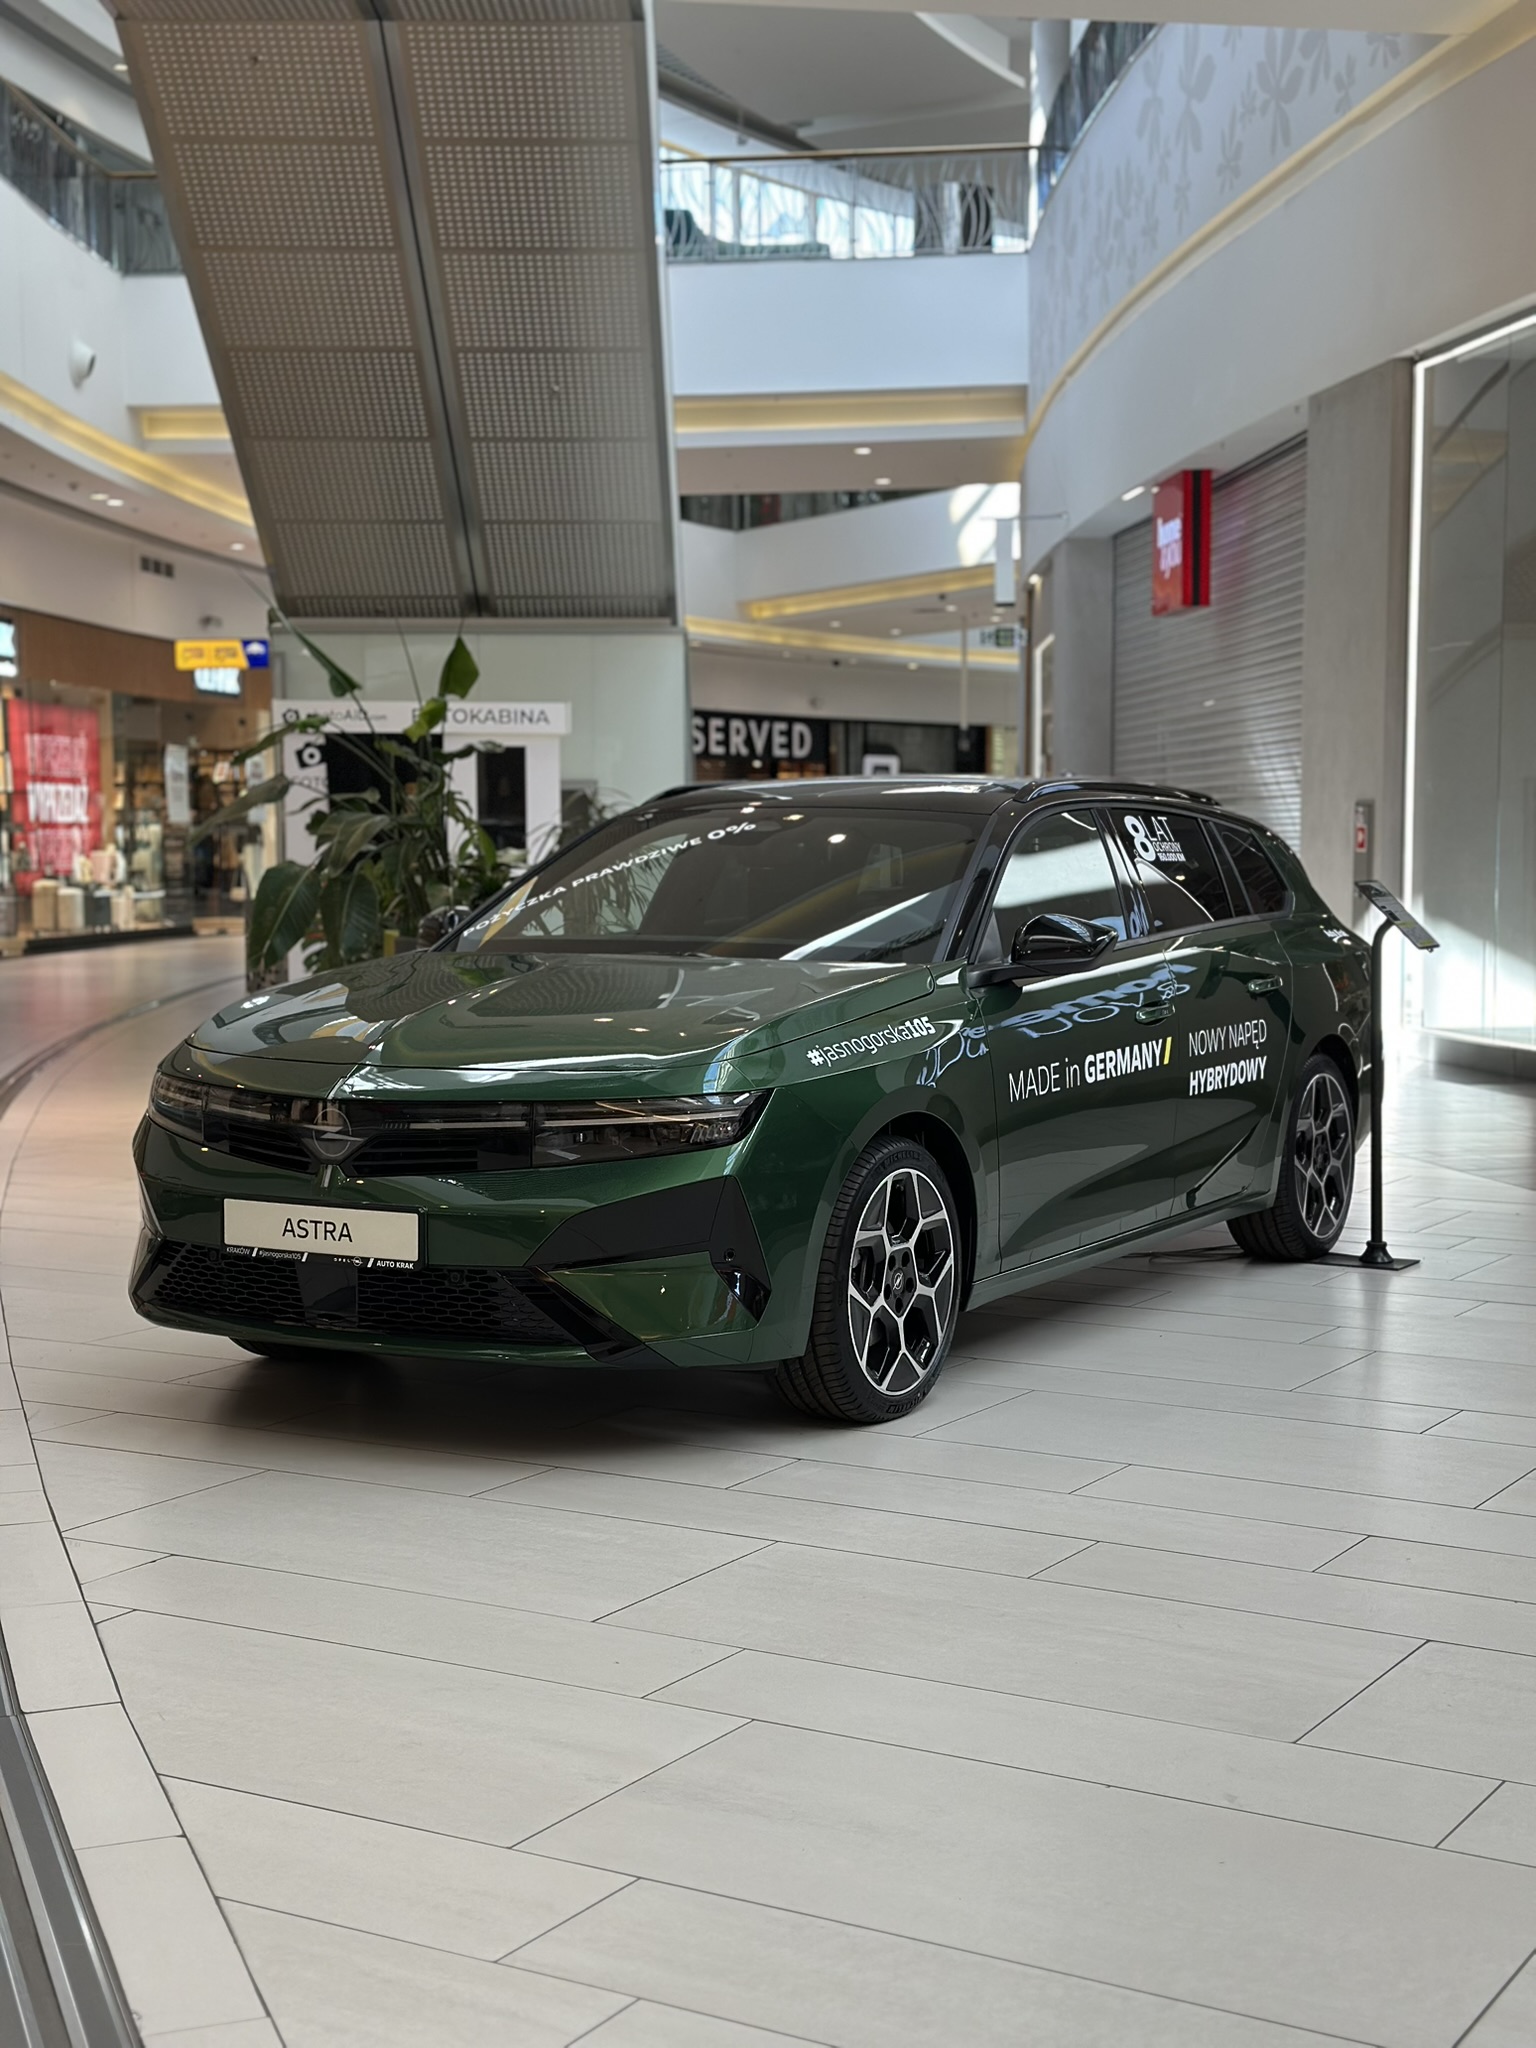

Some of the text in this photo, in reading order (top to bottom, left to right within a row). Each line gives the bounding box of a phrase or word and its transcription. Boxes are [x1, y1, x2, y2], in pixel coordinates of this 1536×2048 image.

[411, 708, 551, 726] FTOKABINA
[690, 716, 813, 759] SERVED
[1123, 815, 1175, 862] 8 LAT
[462, 821, 757, 938] POŻYCZKA PRAWDZIWE 0%
[805, 1015, 937, 1068] #jasnogorska105
[1188, 1019, 1267, 1058] NOWY NAPĘD
[1007, 1038, 1163, 1103] MADE in GERMANY
[1188, 1056, 1268, 1097] HYBRYDOWY
[281, 1217, 353, 1243] ASTRA
[376, 1259, 395, 1269] AUTO
[396, 1261, 415, 1270] KRAK
